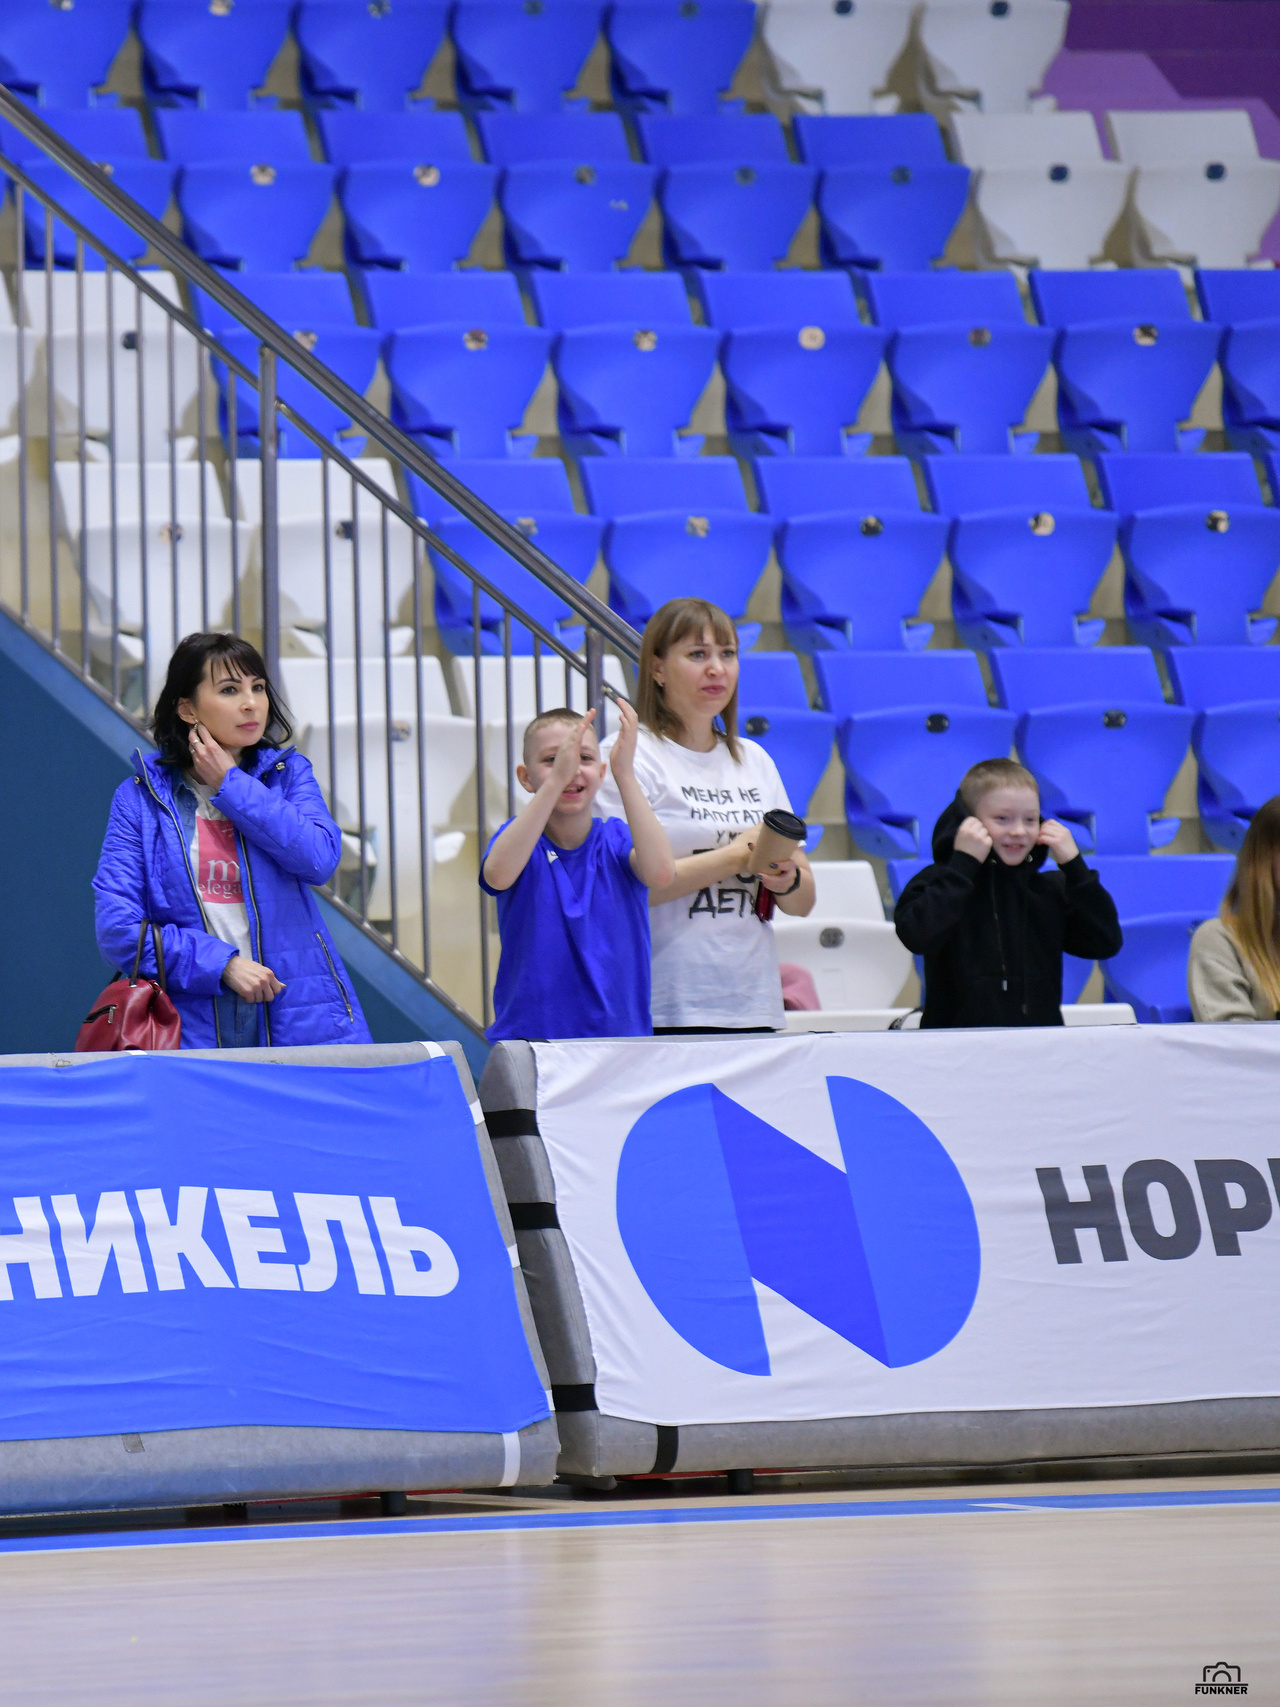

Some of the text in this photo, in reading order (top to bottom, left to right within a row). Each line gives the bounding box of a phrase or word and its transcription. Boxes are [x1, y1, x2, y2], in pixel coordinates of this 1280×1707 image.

[681, 786, 762, 805] МЕНЯ НЕ
[1035, 1158, 1280, 1265] НОР
